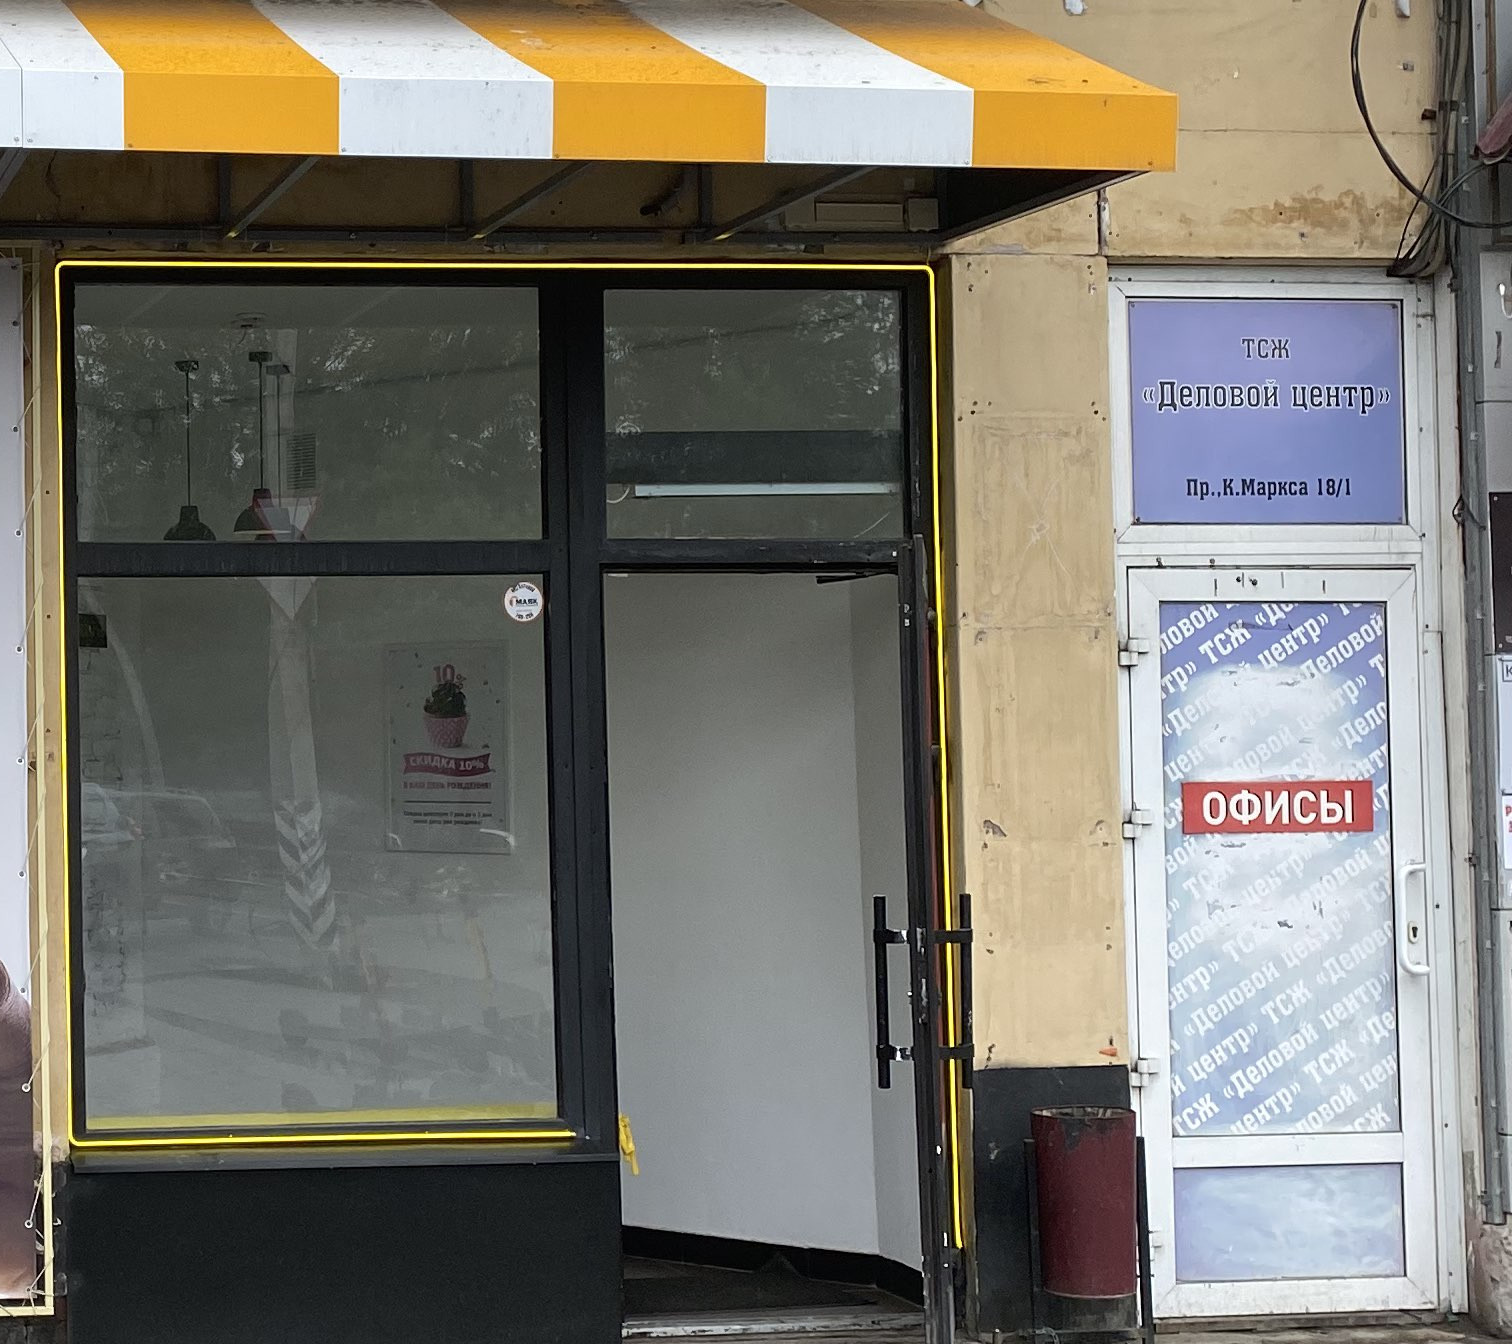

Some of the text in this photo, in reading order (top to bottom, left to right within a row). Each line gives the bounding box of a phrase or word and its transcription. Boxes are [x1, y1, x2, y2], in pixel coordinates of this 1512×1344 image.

[1241, 337, 1291, 360] ТСЖ
[1142, 379, 1392, 417] «Деловой центр»
[1317, 477, 1352, 498] 18/1
[1198, 618, 1252, 664] ТСЖ
[1257, 612, 1330, 670] центр»
[1201, 788, 1354, 826] ОФИСЫ
[1183, 959, 1281, 1038] «Деловой
[1186, 1021, 1260, 1083] центр»
[1260, 978, 1314, 1025] ТСЖ
[1223, 1020, 1320, 1100] «Деловой
[1319, 971, 1391, 1031] центр»
[1303, 1038, 1357, 1085] ТСЖ
